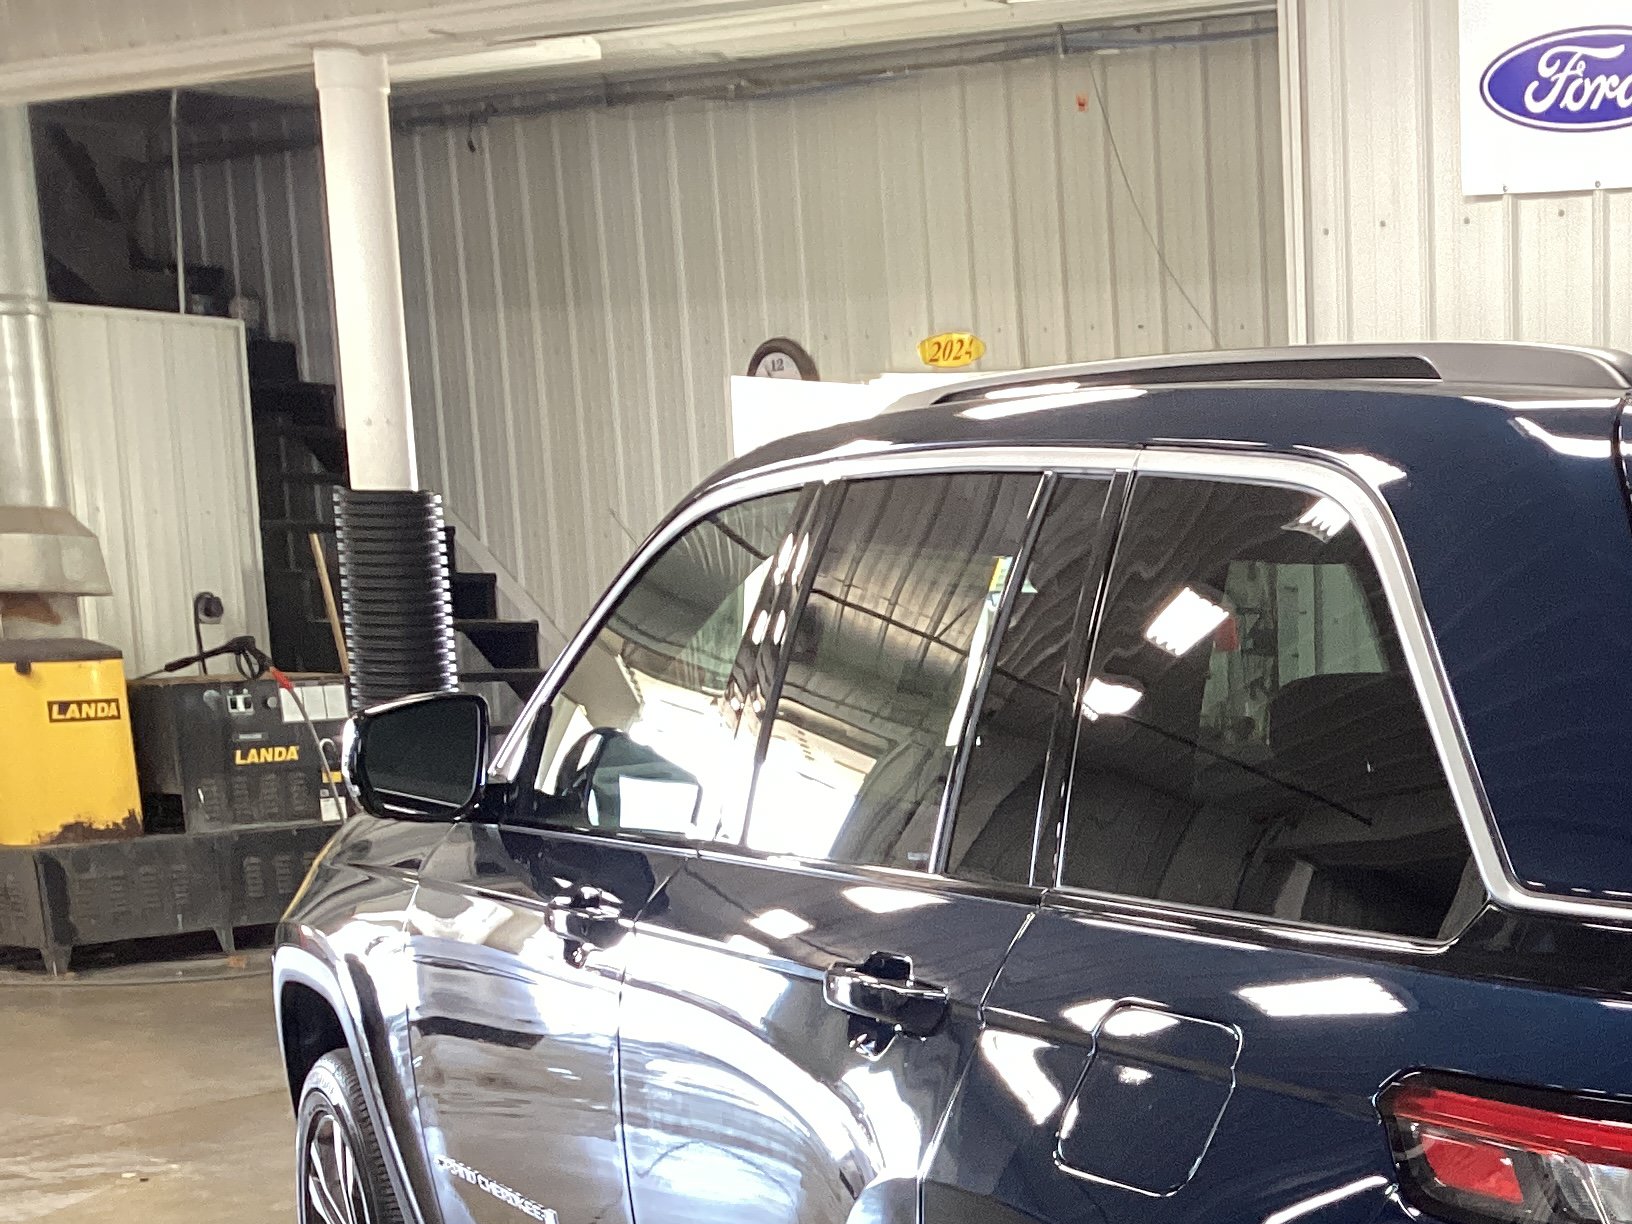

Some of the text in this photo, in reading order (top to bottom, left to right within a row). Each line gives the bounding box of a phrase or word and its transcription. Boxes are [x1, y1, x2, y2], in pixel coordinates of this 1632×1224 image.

[771, 358, 784, 372] 12
[51, 701, 119, 721] LANDA
[234, 746, 299, 766] LANDA
